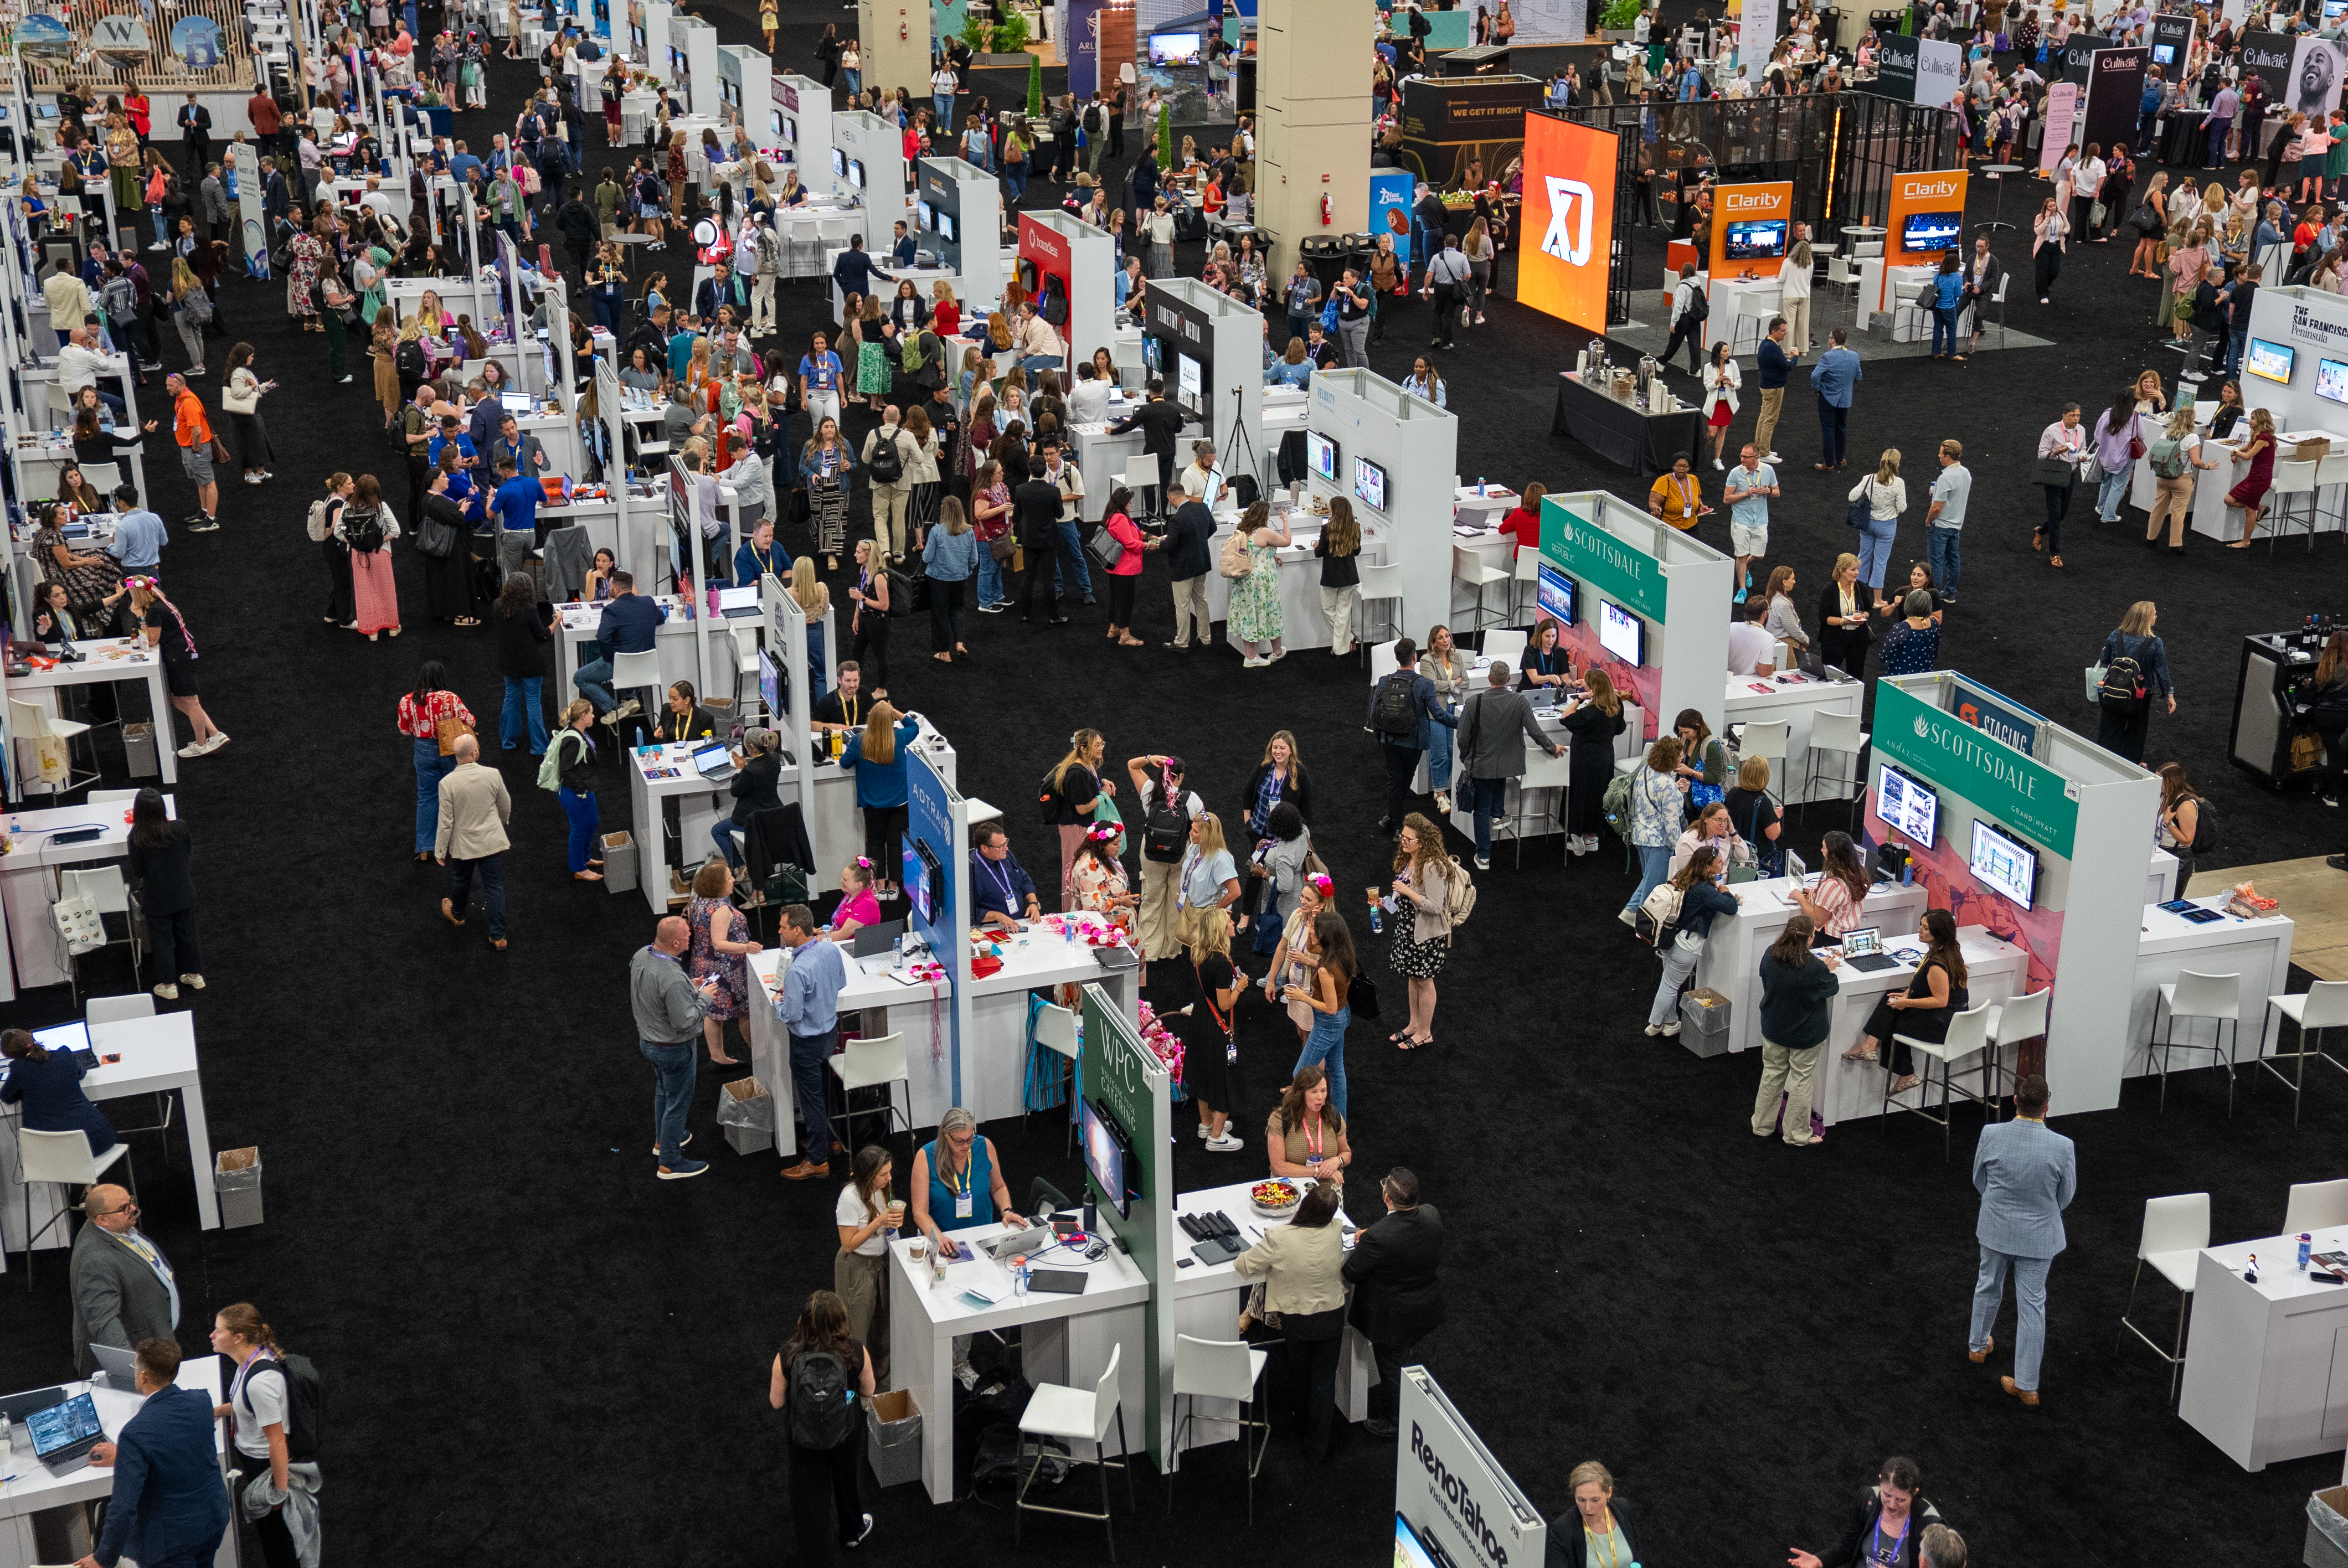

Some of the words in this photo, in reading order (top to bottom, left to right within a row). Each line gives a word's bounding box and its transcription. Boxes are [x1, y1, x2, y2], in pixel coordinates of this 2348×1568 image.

[102, 22, 133, 42] W
[2160, 23, 2185, 36] Cultivate
[1881, 48, 1915, 69] Cultivate
[1921, 56, 1956, 77] Cultivate
[2102, 56, 2139, 69] Cultivate
[2244, 48, 2288, 69] Cultivate
[1496, 106, 1522, 115] RIGHT
[239, 167, 255, 176] MEET-UP
[1904, 181, 1958, 197] Clarity
[1727, 193, 1782, 209] Clarity
[1036, 235, 1058, 258] boundless
[1157, 304, 1178, 331] LUMETRY
[1185, 319, 1201, 343] MEDIA
[2293, 314, 2308, 327] SAN
[2291, 324, 2328, 343] Peninsula
[1317, 386, 1335, 405] VELOXITY
[1551, 544, 1575, 564] REPUBLIC
[1574, 527, 1641, 580] SCOTTSDALE
[1630, 596, 1651, 612] SCOTTSDALE
[1930, 723, 2037, 800] SCOTTSDALE
[2067, 787, 2077, 797] H15
[2011, 805, 2032, 822] GRAND
[2036, 819, 2057, 836] HYATT
[2014, 819, 2036, 835] SCOTTSDALE
[2037, 832, 2051, 843] RESORT
[1100, 1018, 1134, 1093] WPC
[1101, 1066, 1122, 1100] WOLFGANG
[1124, 1096, 1135, 1116] PUCK
[1101, 1076, 1135, 1131] CATERING
[1411, 1419, 1508, 1568] RenoTahoe
[1510, 1523, 1520, 1540] J18
